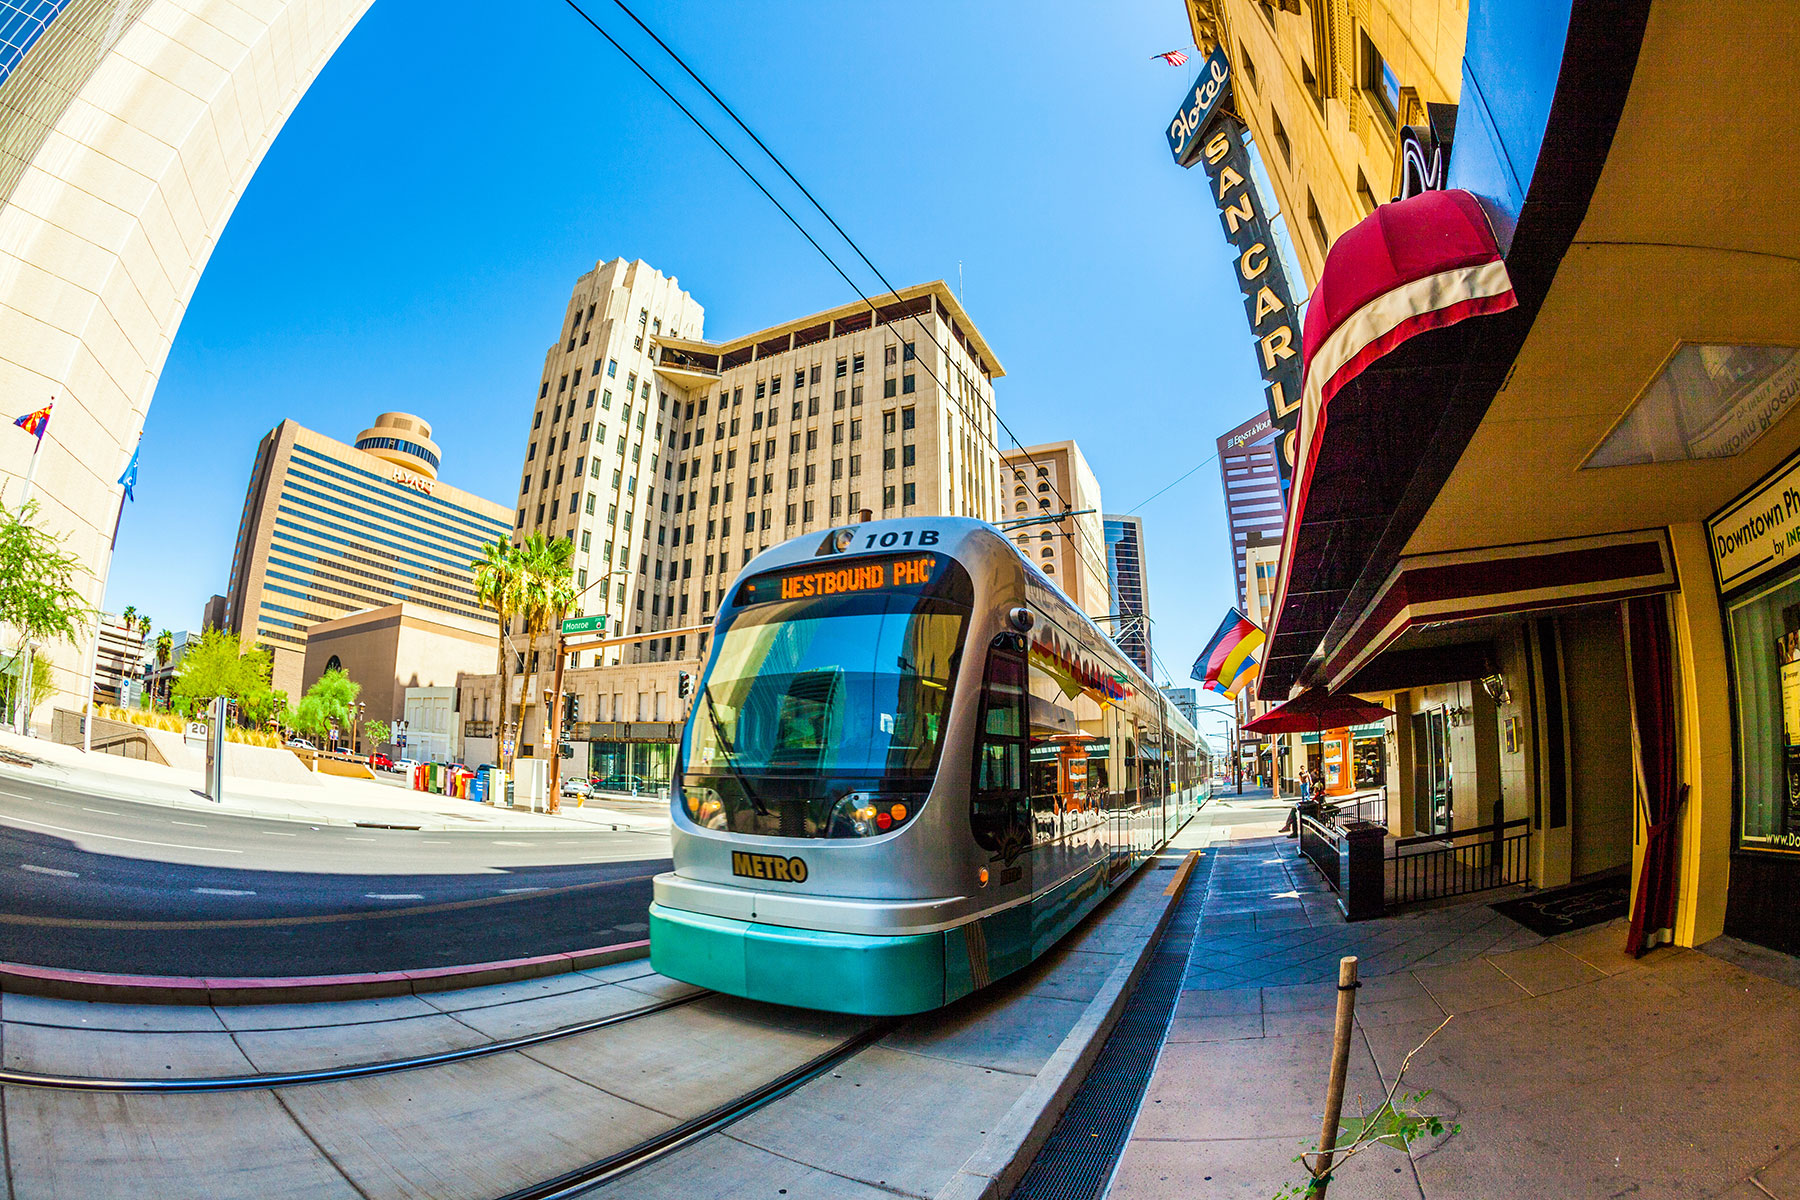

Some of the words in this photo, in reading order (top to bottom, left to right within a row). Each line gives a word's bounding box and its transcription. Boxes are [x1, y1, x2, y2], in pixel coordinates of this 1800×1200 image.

[1171, 60, 1229, 153] Hotel
[1205, 131, 1255, 235] SAN
[392, 468, 435, 493] HYATT
[1717, 503, 1785, 559] Downtown
[1783, 487, 1800, 519] Ph
[865, 529, 940, 549] 101B
[1773, 539, 1785, 556] by
[781, 564, 884, 600] WESTBOUND
[565, 621, 589, 631] Monroe
[733, 852, 808, 882] METRO
